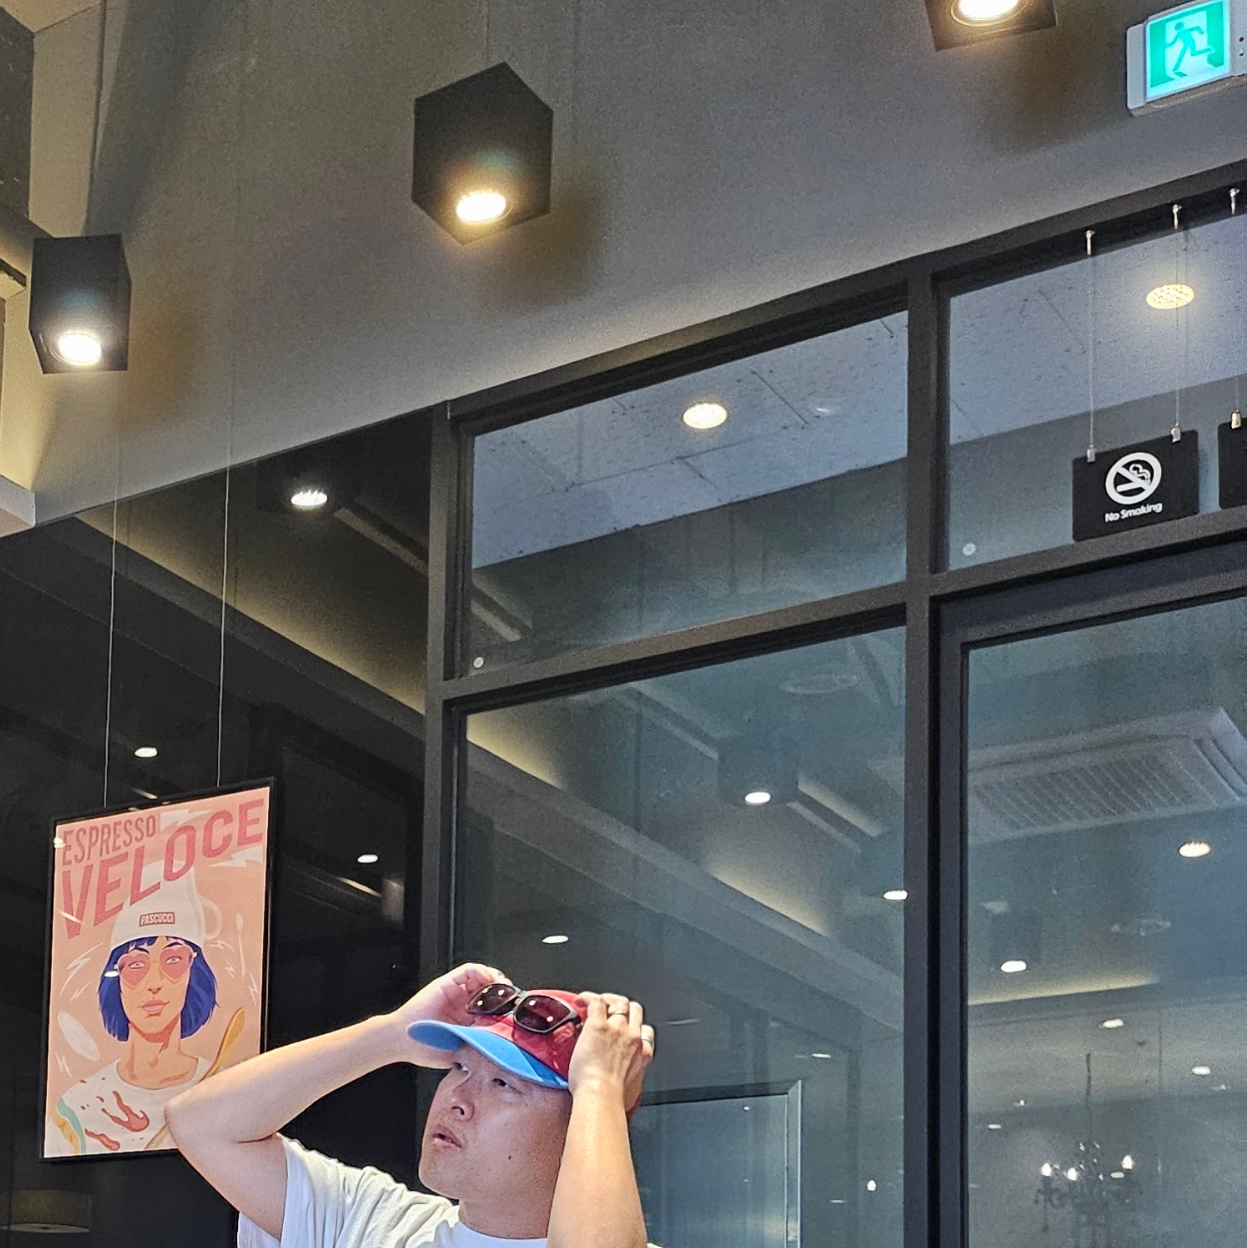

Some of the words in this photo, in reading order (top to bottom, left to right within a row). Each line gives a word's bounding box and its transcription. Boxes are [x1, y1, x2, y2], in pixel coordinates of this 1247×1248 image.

[1105, 512, 1120, 522] No
[1120, 503, 1163, 519] Smoking
[62, 815, 156, 866] ESPRESSO
[62, 798, 264, 940] VELOCE
[140, 913, 174, 926] PASCUCCI
